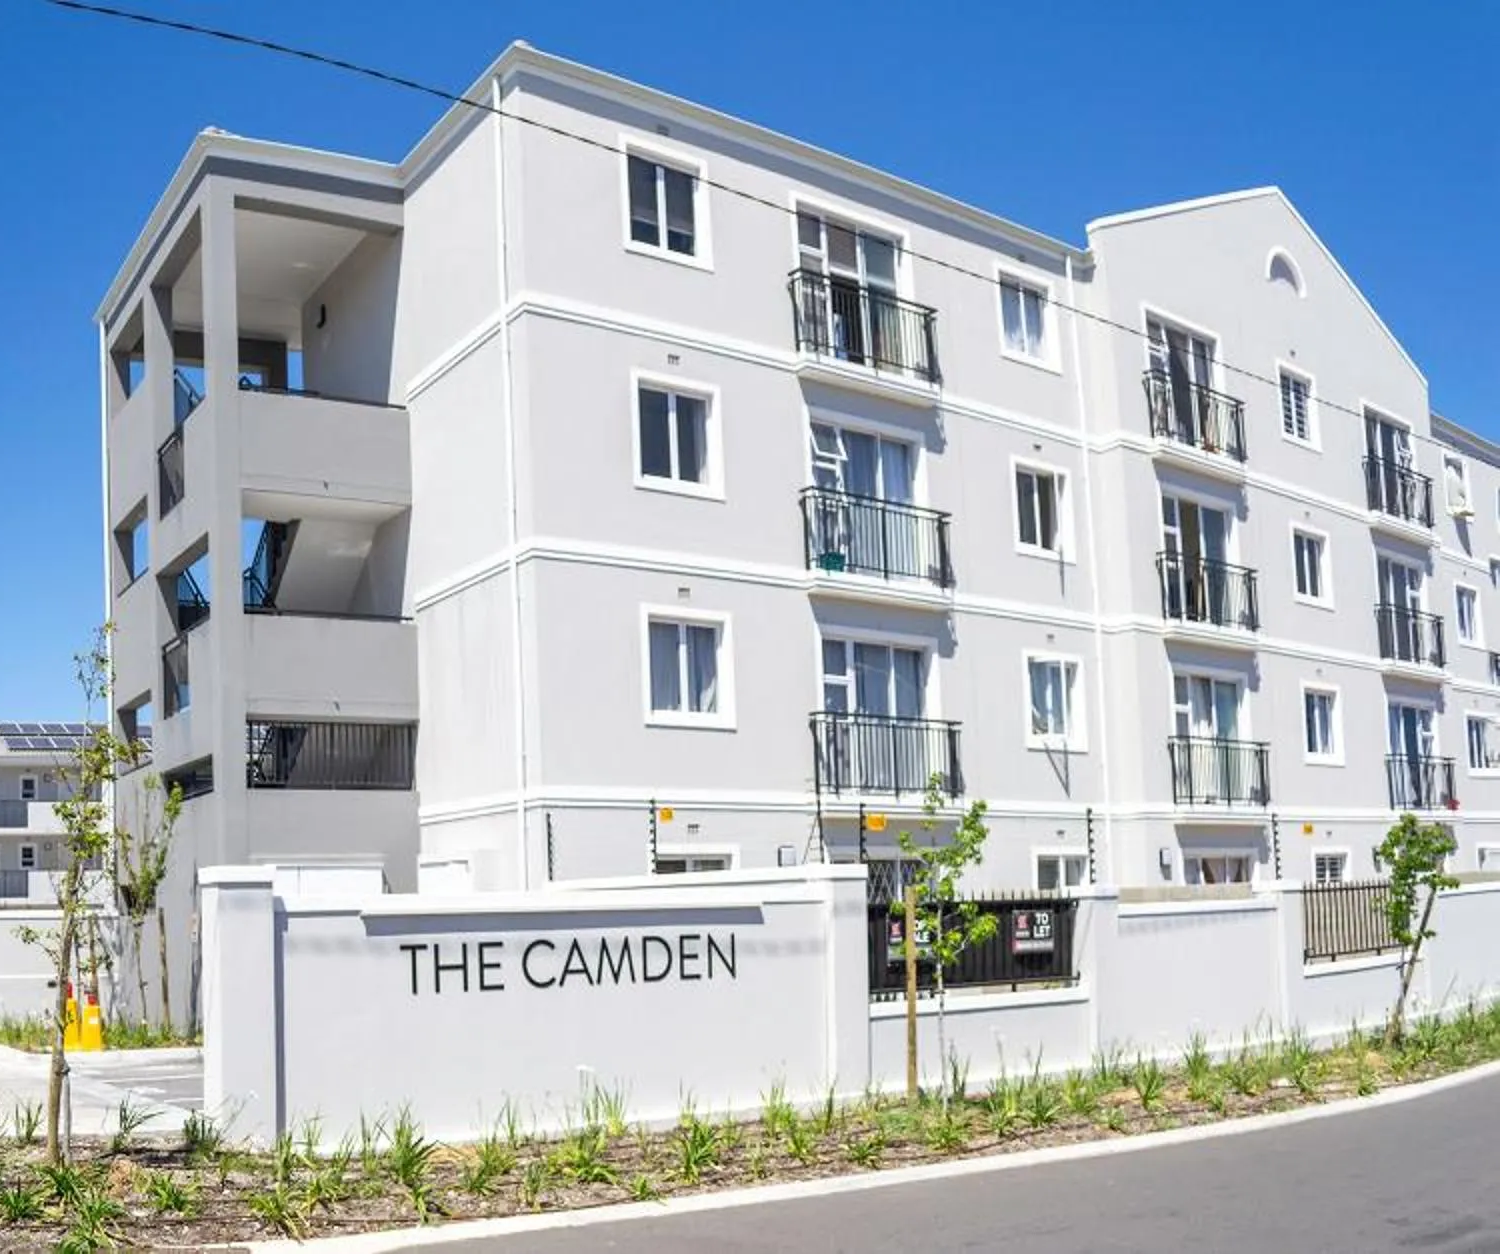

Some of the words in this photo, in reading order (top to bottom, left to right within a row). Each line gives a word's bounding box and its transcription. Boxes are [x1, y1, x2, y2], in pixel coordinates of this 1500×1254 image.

[1034, 912, 1049, 925] TO
[1033, 925, 1051, 938] LET
[399, 941, 505, 995] THE
[521, 932, 737, 989] CAMDEN
